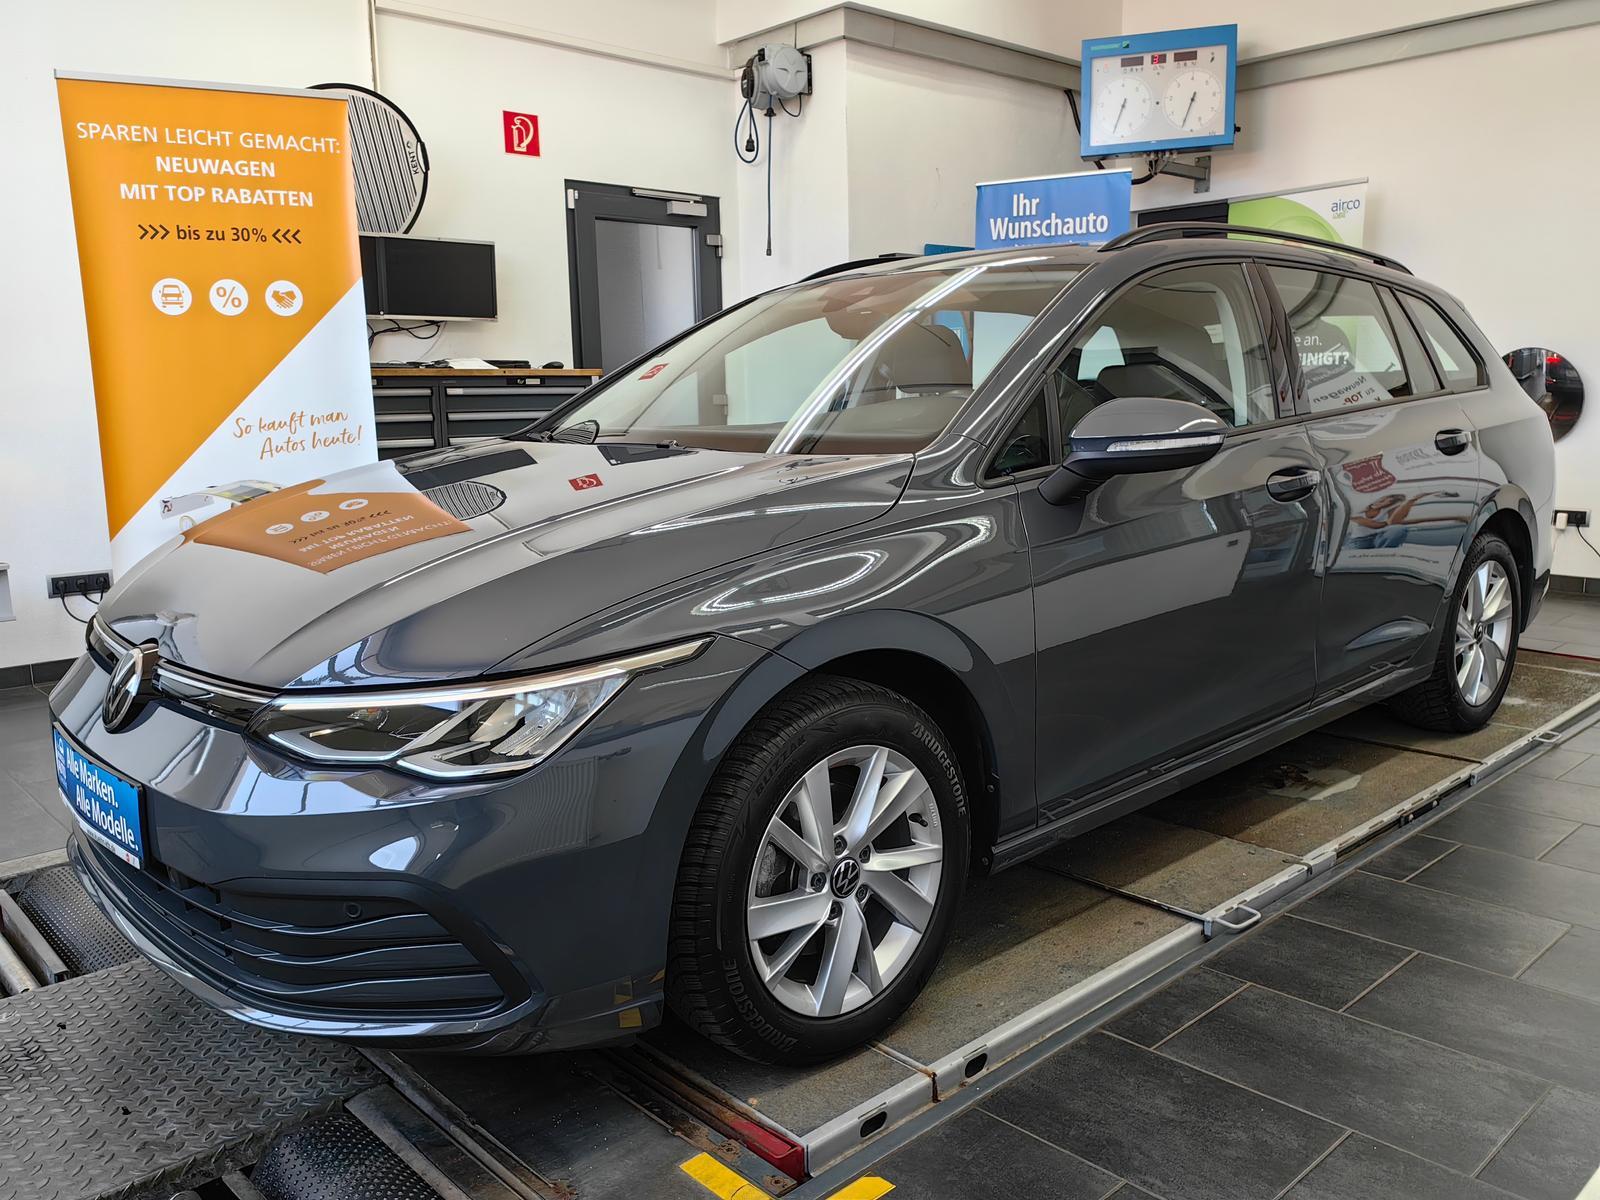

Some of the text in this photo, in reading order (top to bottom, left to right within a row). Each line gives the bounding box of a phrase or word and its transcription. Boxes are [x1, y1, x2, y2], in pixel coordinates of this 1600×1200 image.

[1152, 54, 1160, 64] 3
[76, 122, 341, 154] SPAREN LEICHT GEMACHT:
[155, 155, 276, 177] NEUWAGEN
[408, 150, 420, 175] KENT
[119, 183, 314, 207] MIT TOP RABATTEN
[1012, 193, 1040, 217] Ihr
[1331, 199, 1361, 212] airco
[176, 224, 268, 243] bis zu 30%
[989, 212, 1109, 240] Wunschauto
[1303, 335, 1322, 346] an.
[1299, 351, 1350, 366] INIGT?
[233, 410, 349, 438] So kauft man
[260, 425, 362, 460] Autos heute!
[66, 747, 79, 779] Alle
[79, 759, 119, 808] Marken.
[911, 721, 967, 817] BRIDGESTONE
[76, 784, 91, 818] Alle
[91, 798, 139, 851] Modelle.
[722, 958, 800, 1053] BRIDGESTONE
